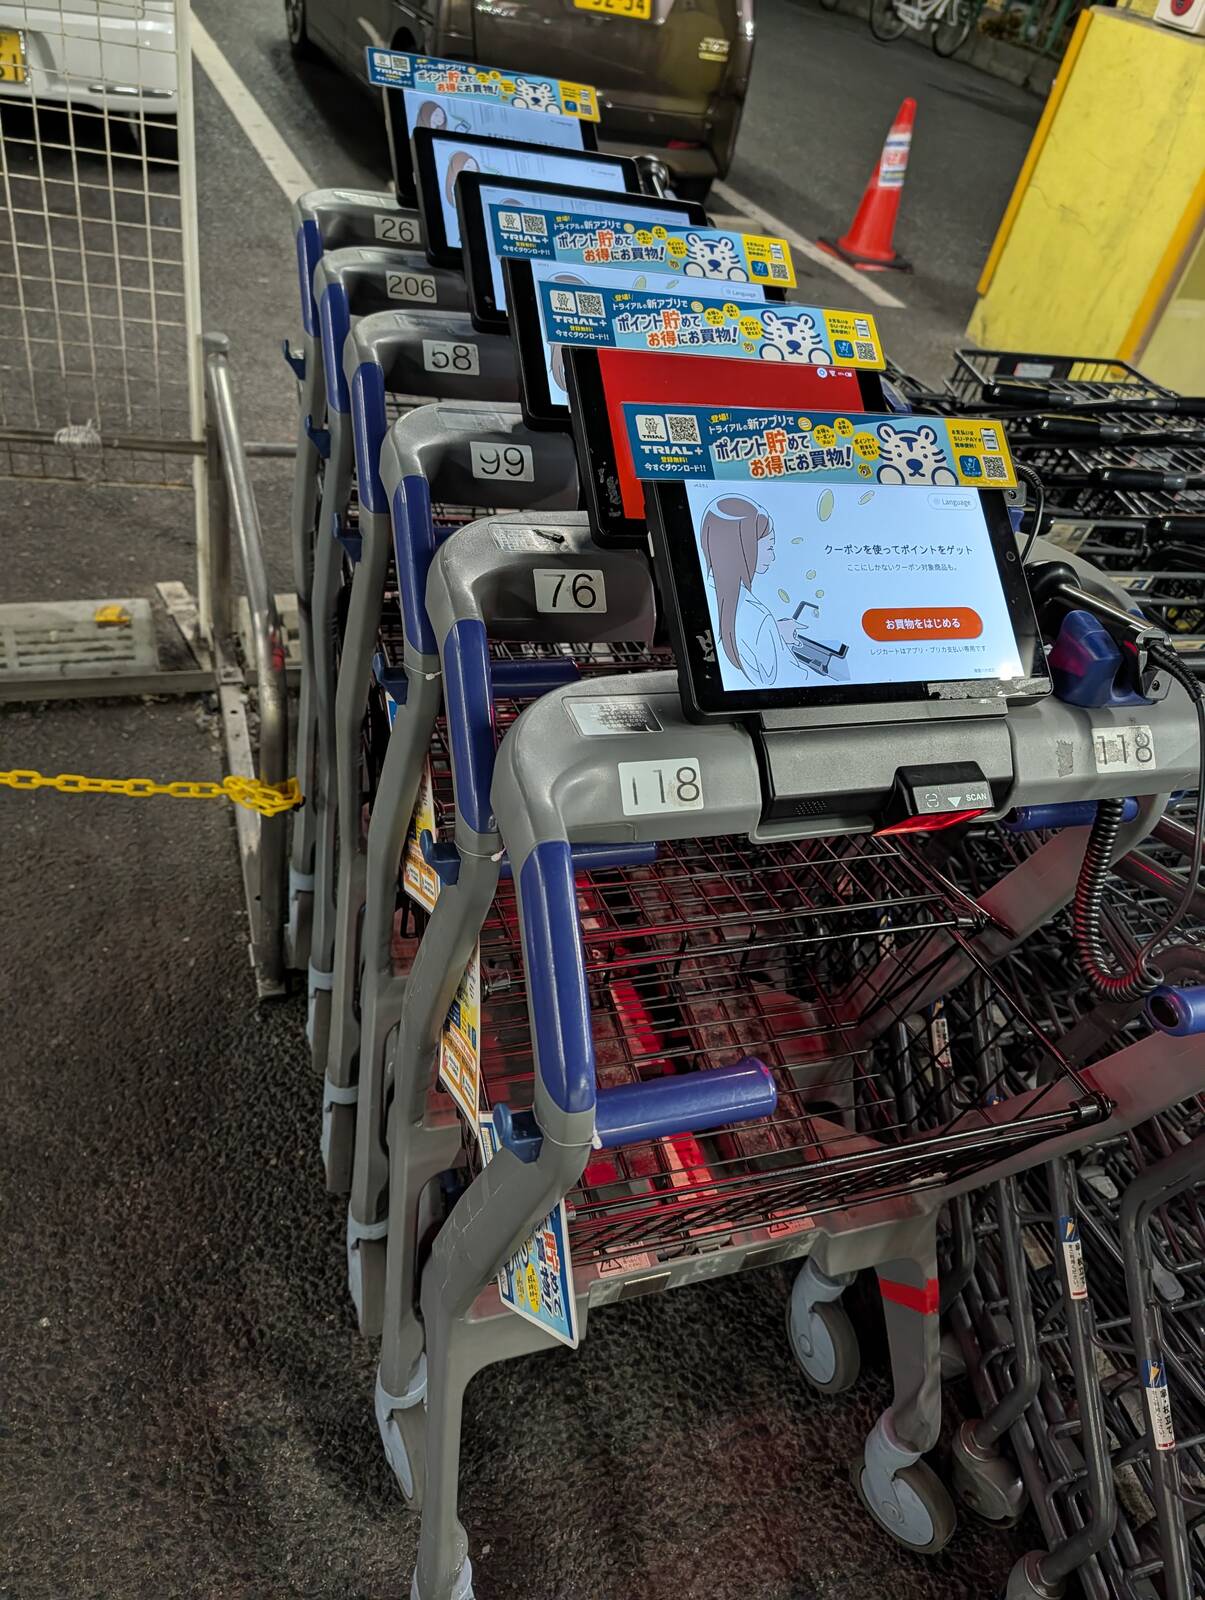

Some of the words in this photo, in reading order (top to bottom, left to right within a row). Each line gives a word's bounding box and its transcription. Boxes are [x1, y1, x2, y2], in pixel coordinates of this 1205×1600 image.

[381, 218, 414, 242] 26
[557, 230, 632, 249] ポイント貯めて
[584, 247, 664, 263] お得にお買物!
[388, 275, 436, 298] 206
[617, 310, 701, 332] ポイント貯めて
[647, 327, 738, 347] お得にお買物!
[432, 345, 472, 371] 58
[708, 415, 795, 435] トライアルの新アプリで
[642, 433, 665, 441] TRIAL
[715, 429, 811, 461] ポイント貯めて
[480, 447, 525, 477] 99
[644, 463, 707, 473] 今すぐダウンロード!!
[751, 445, 853, 477] お得にお買物!
[940, 497, 972, 507] Language
[824, 543, 974, 556] クーポンを使ってポイントをゲット
[847, 562, 958, 573] ここにしかないクーポン対象商品も。
[543, 573, 597, 609] 76
[885, 616, 961, 631] お買物をはじめる
[1095, 733, 1153, 766] 118
[631, 766, 700, 806] 118
[965, 792, 988, 802] SCAN
